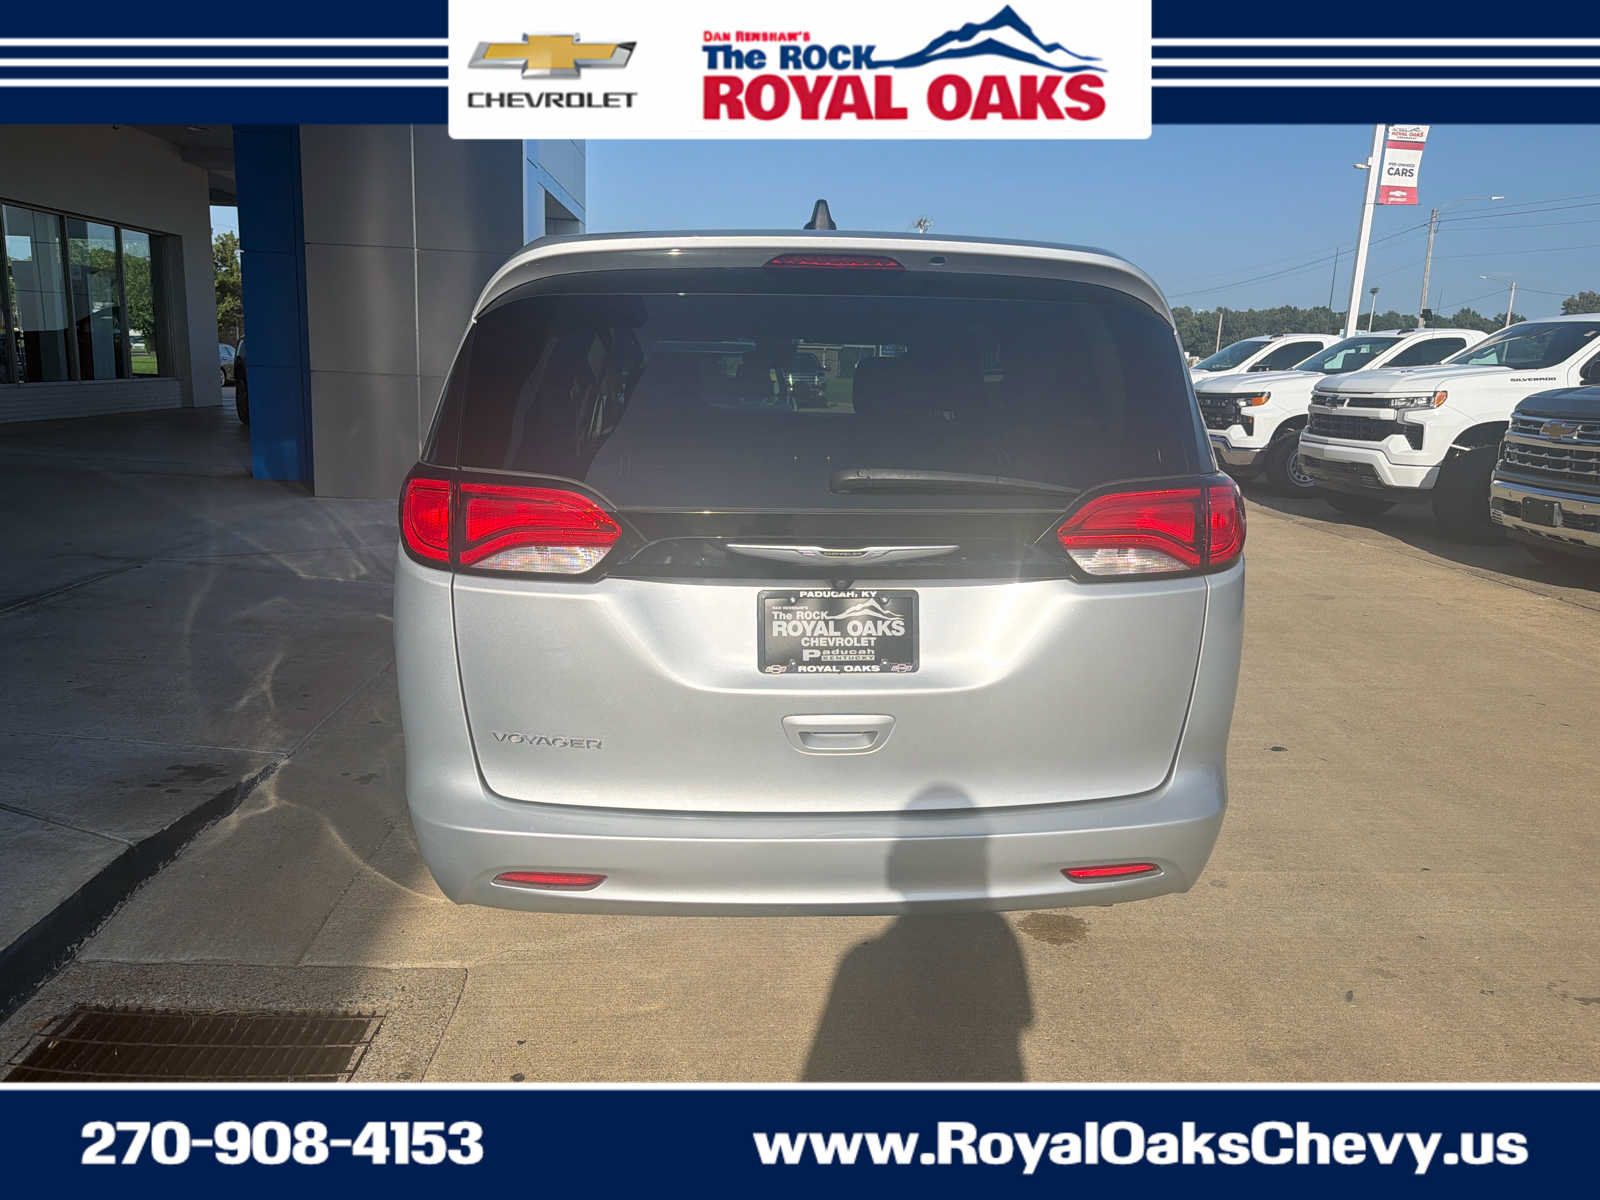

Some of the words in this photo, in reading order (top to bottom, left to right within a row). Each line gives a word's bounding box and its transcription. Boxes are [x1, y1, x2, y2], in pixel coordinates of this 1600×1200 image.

[1387, 167, 1414, 177] CARS
[772, 611, 793, 620] The
[796, 611, 829, 620] ROCK
[772, 621, 841, 637] ROYAL
[847, 621, 905, 637] OAKS
[801, 637, 877, 647] CHEVROLET
[802, 648, 875, 661] Paducah
[798, 665, 840, 673] ROYAL
[844, 665, 881, 673] OAKS
[491, 732, 602, 750] VOYAGER
